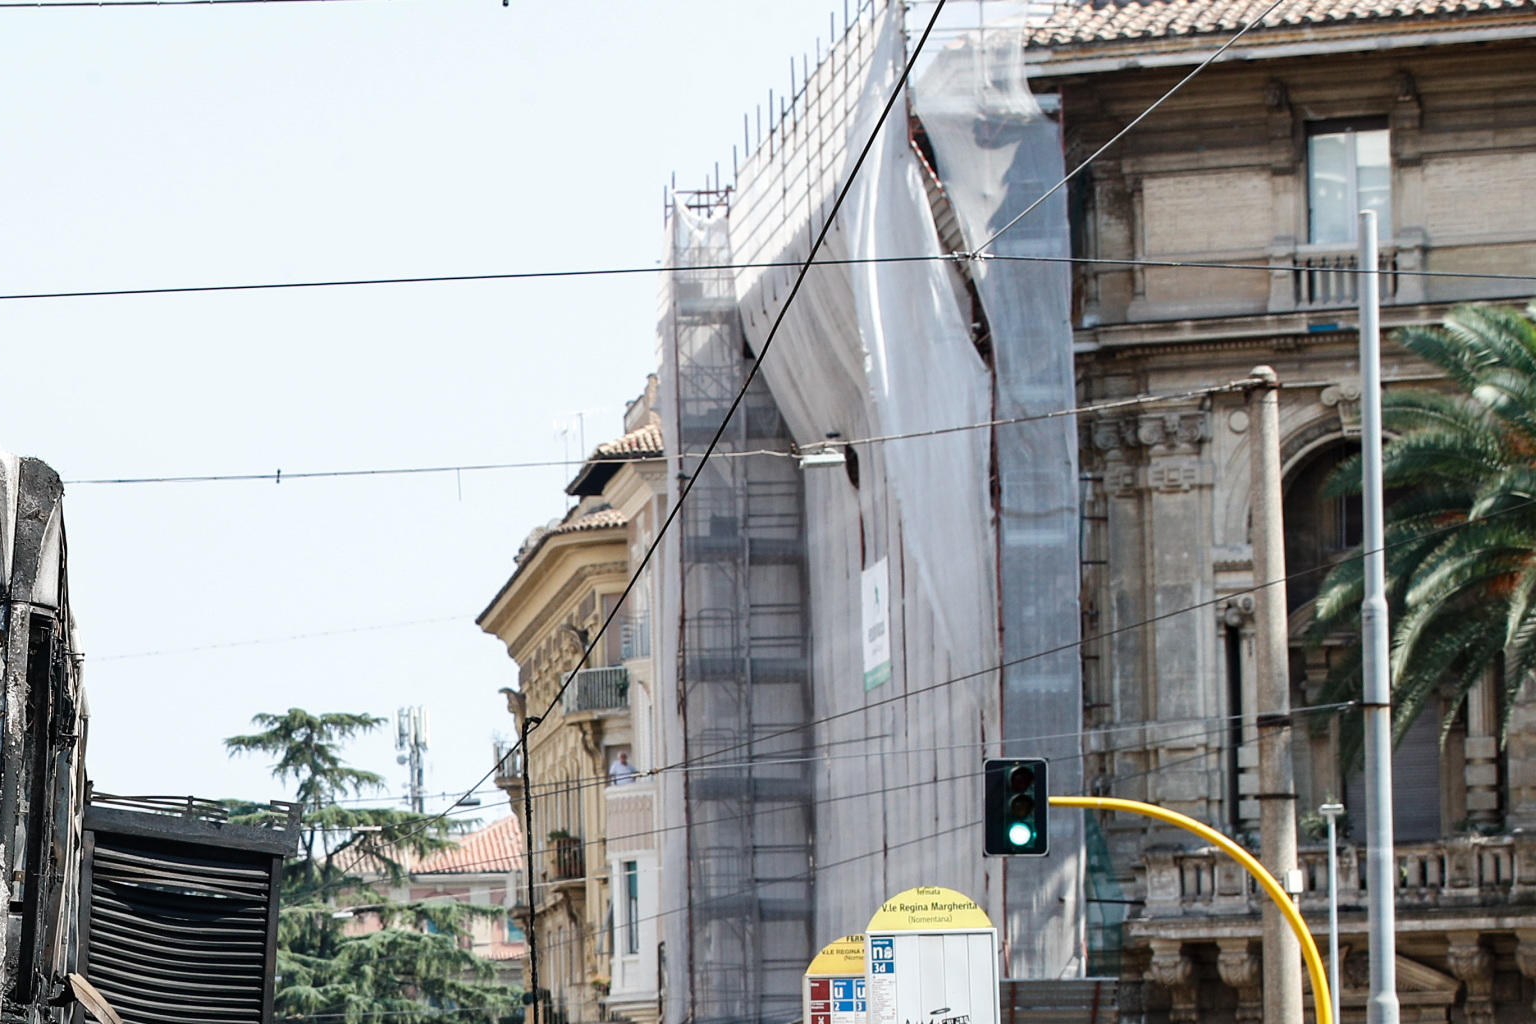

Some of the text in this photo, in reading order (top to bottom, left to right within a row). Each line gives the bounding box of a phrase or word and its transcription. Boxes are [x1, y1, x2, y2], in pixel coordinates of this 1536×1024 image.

[881, 901, 978, 914] V.le Regina Margherita
[908, 914, 953, 924] (Nomentana)
[873, 962, 886, 973] 3d
[834, 1001, 841, 1011] 2
